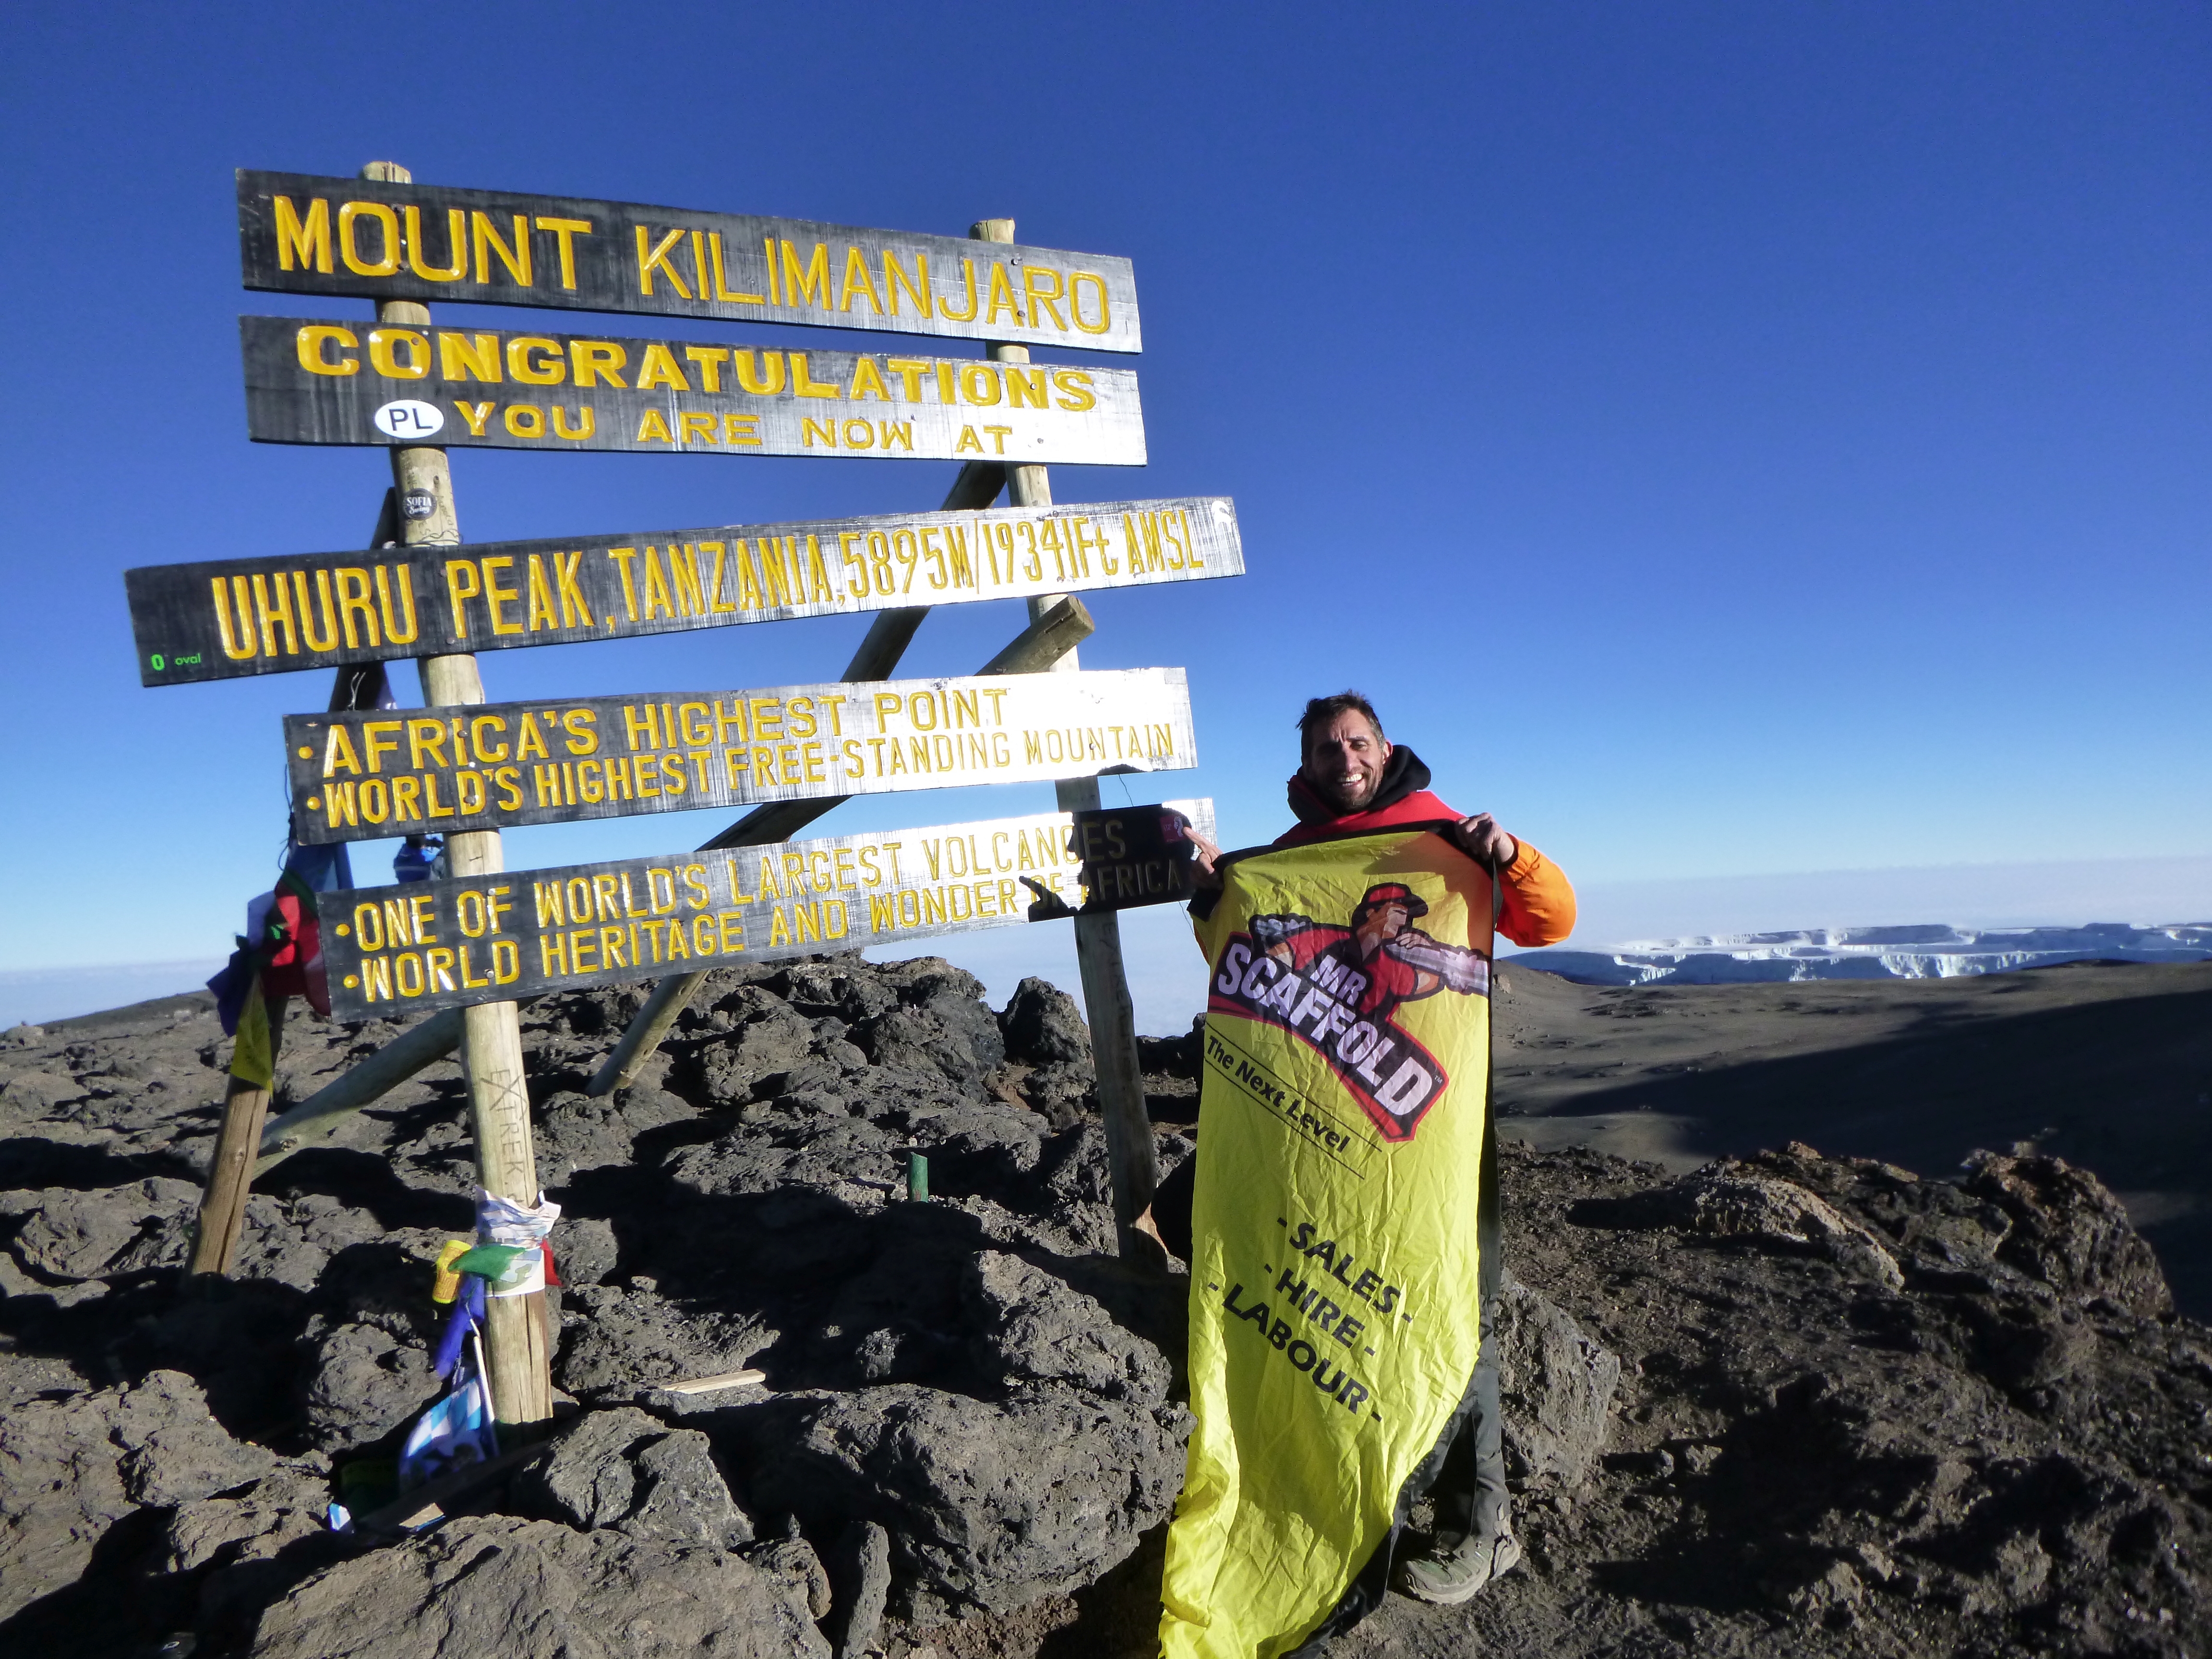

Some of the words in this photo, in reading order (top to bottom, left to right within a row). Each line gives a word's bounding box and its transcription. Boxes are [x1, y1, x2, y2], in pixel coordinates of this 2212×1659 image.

[274, 195, 592, 289] MOUNT
[635, 226, 1110, 334] KILIMANJARO
[297, 325, 1096, 411] CONGRATULATIONS
[389, 408, 433, 431] PL
[454, 400, 596, 440] YOU
[637, 409, 762, 445] ARE
[802, 418, 913, 450] NOW
[955, 425, 1012, 454] AT
[406, 496, 432, 506] SOFIA
[212, 564, 418, 660] UHURU
[1123, 510, 1204, 573] AMSL
[174, 652, 201, 666] oval
[323, 708, 600, 778] AFRICA'S
[624, 695, 846, 751] HIGHEST
[874, 687, 1008, 734] POINT
[323, 767, 524, 828] WORLD'S
[535, 750, 712, 808] HIGHEST
[725, 731, 1010, 790] FREE-STANDING
[1023, 723, 1173, 765] MOUNTAIN
[355, 895, 437, 952] ONE
[456, 886, 513, 938] OF
[534, 863, 709, 929] WORLD'S
[728, 842, 902, 906] LARGEST
[922, 819, 1126, 881] VOLCANOES
[360, 940, 521, 1002] WORLD
[540, 911, 744, 978] HERITAGE
[770, 900, 848, 947] AND
[869, 878, 1018, 934] WONDER
[1030, 872, 1064, 909] OF
[1080, 858, 1181, 904] AFRICA
[1217, 943, 1433, 1116] SCAFFOLD
[1310, 955, 1367, 1006] MR
[1207, 1035, 1235, 1069] The
[1235, 1059, 1286, 1108] Next
[1286, 1104, 1351, 1153] Level
